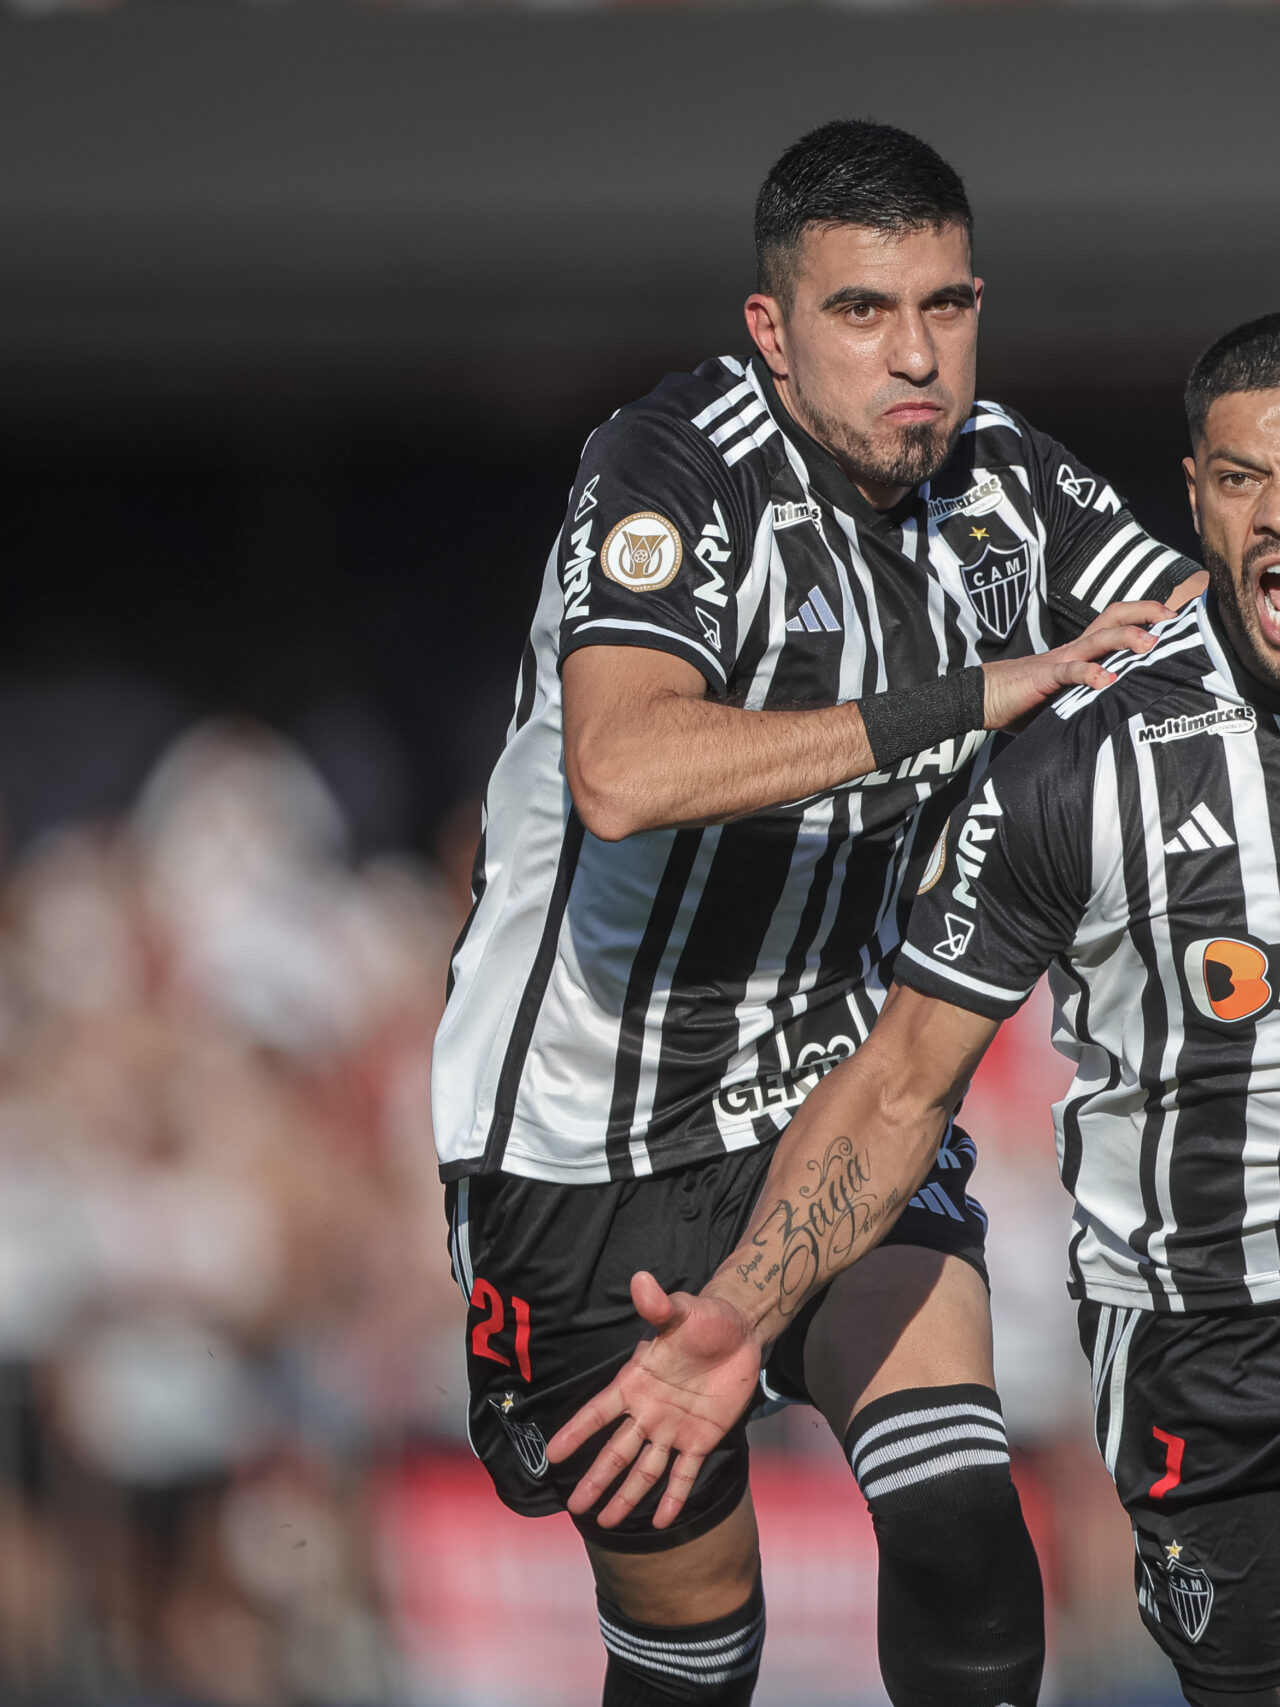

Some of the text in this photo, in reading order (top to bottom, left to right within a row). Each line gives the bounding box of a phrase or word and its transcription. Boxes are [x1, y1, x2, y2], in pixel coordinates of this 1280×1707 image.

[564, 519, 597, 620] MRV
[693, 499, 732, 608] MRV
[973, 557, 1021, 587] CAM
[1138, 707, 1254, 742] Multimarcas
[952, 777, 1003, 909] MRV
[470, 1278, 532, 1382] 21
[1149, 1426, 1185, 1498] 7
